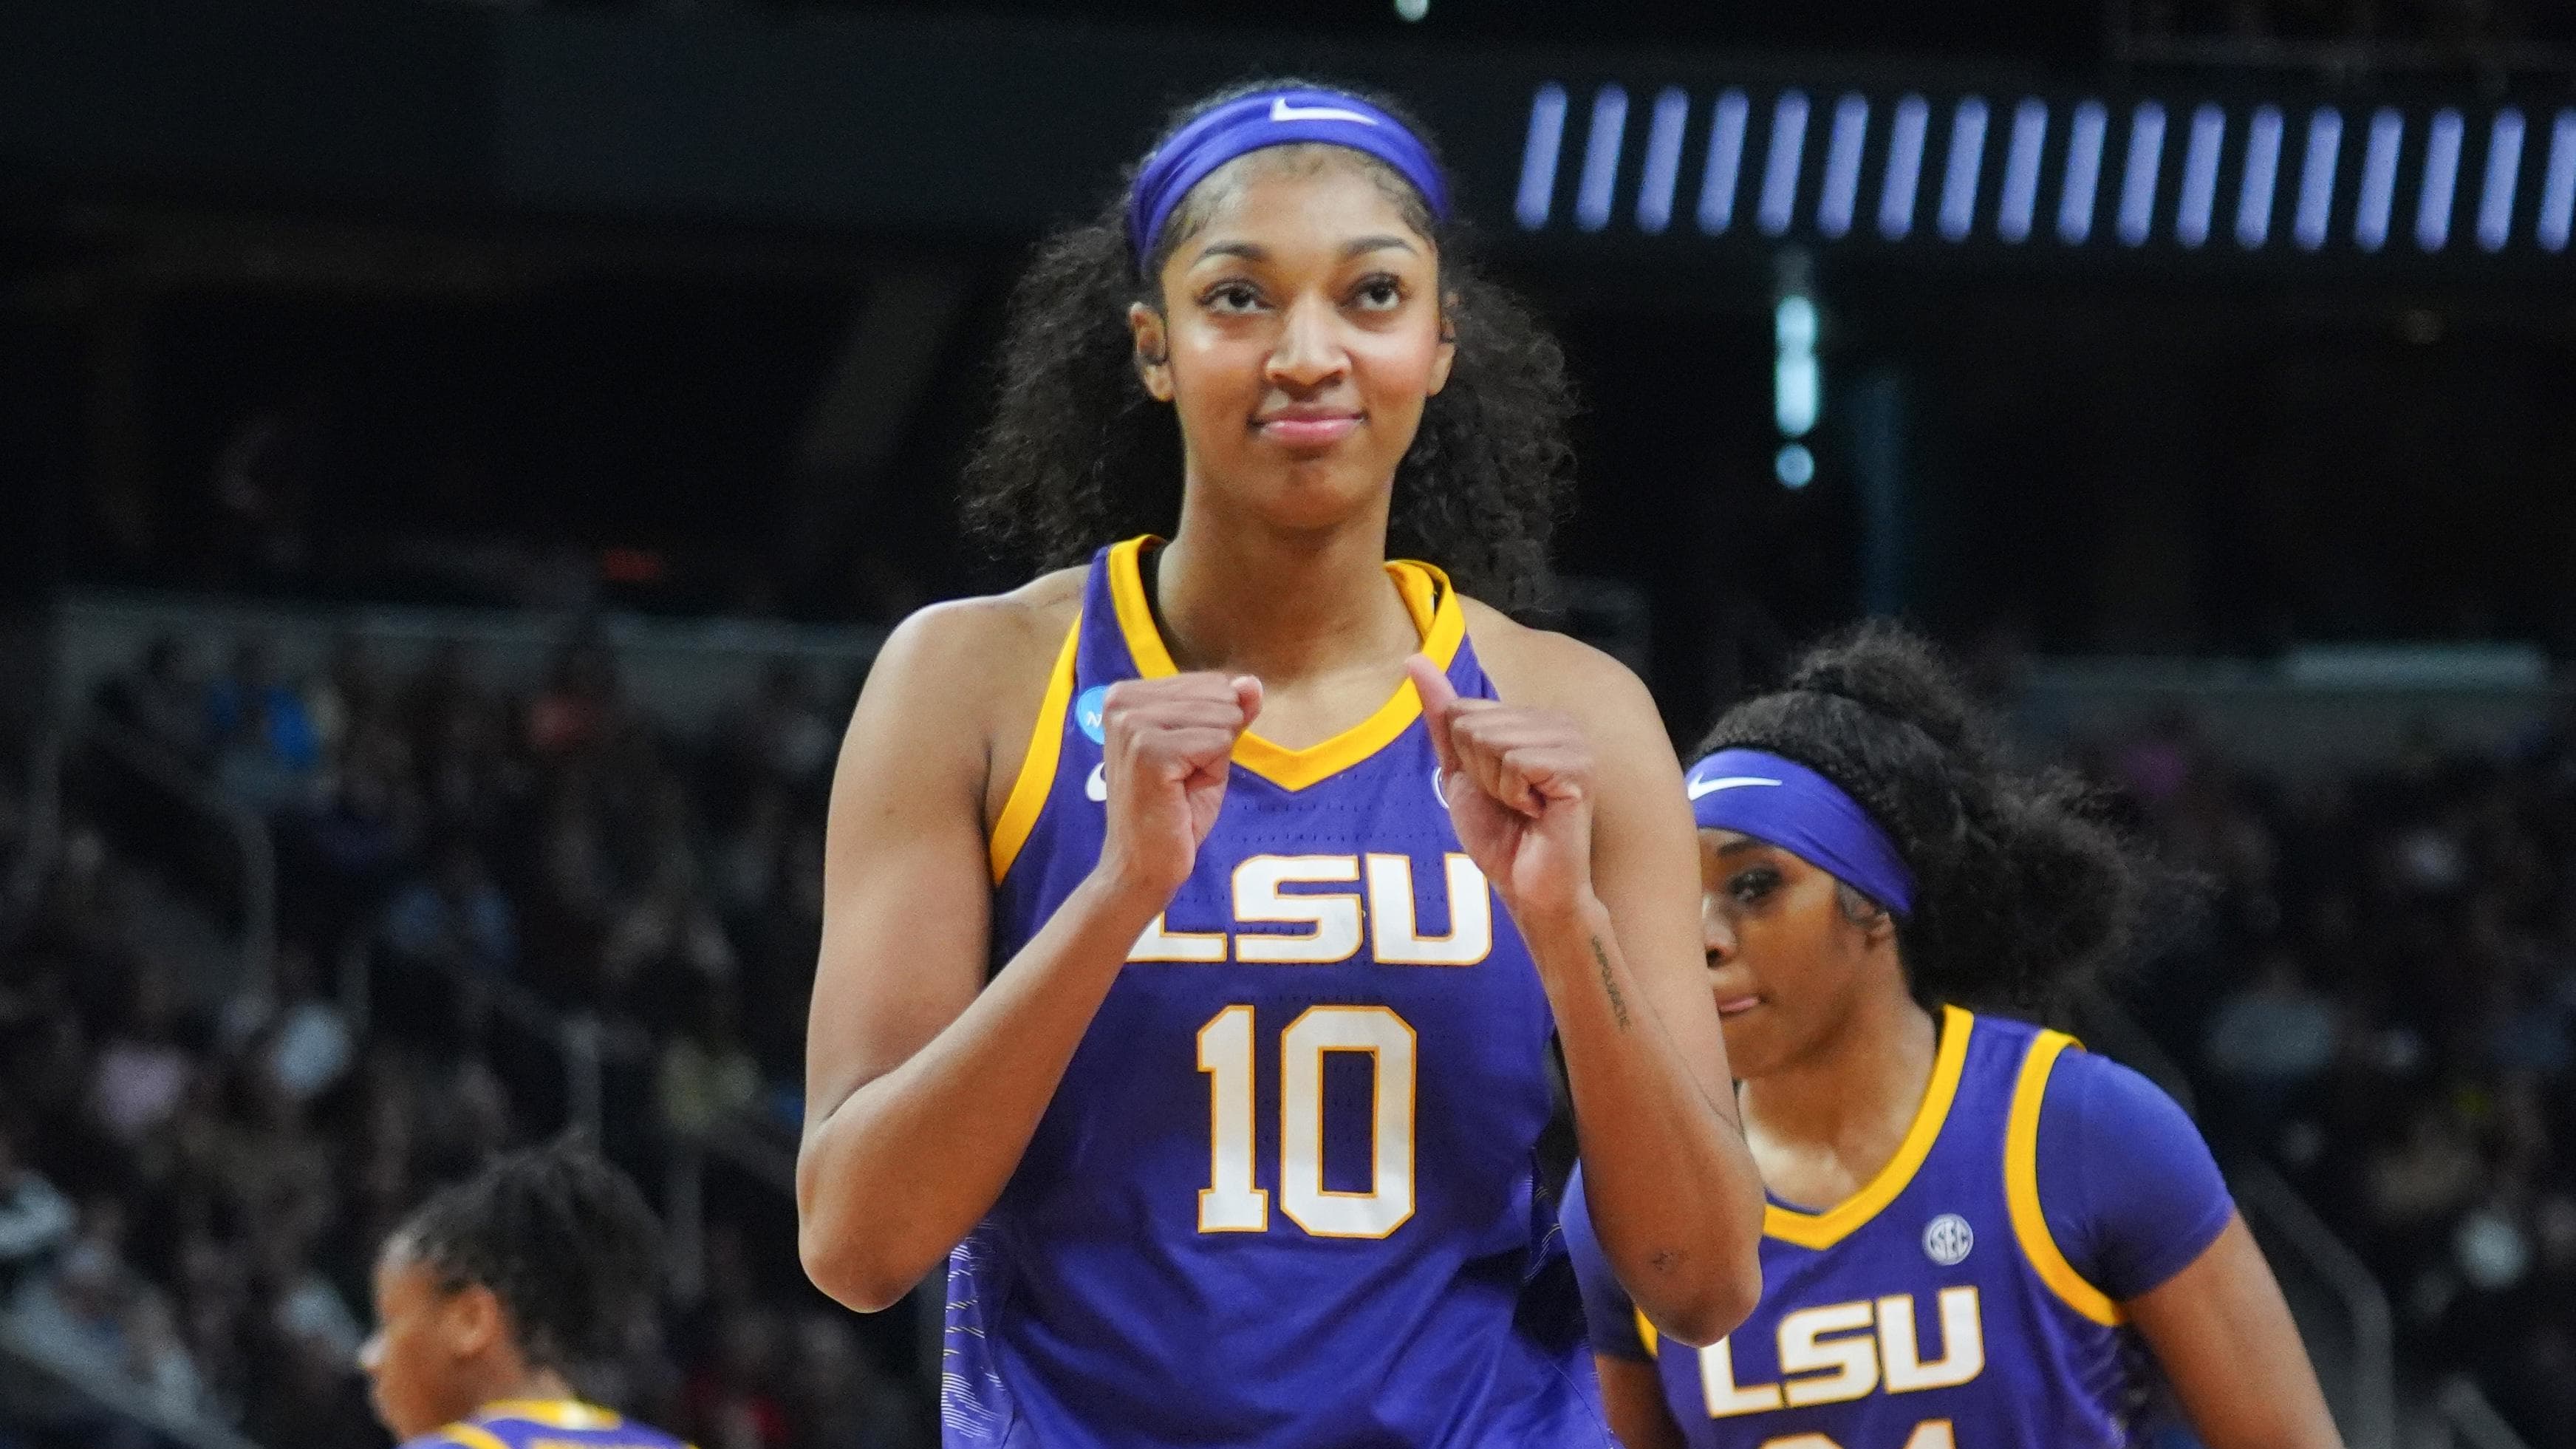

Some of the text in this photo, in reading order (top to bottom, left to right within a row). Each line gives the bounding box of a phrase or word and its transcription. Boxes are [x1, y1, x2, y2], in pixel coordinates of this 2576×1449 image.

[1197, 1005, 1417, 1238] 10
[1929, 1218, 1970, 1260] SEC
[1701, 1285, 1985, 1419] LSU
